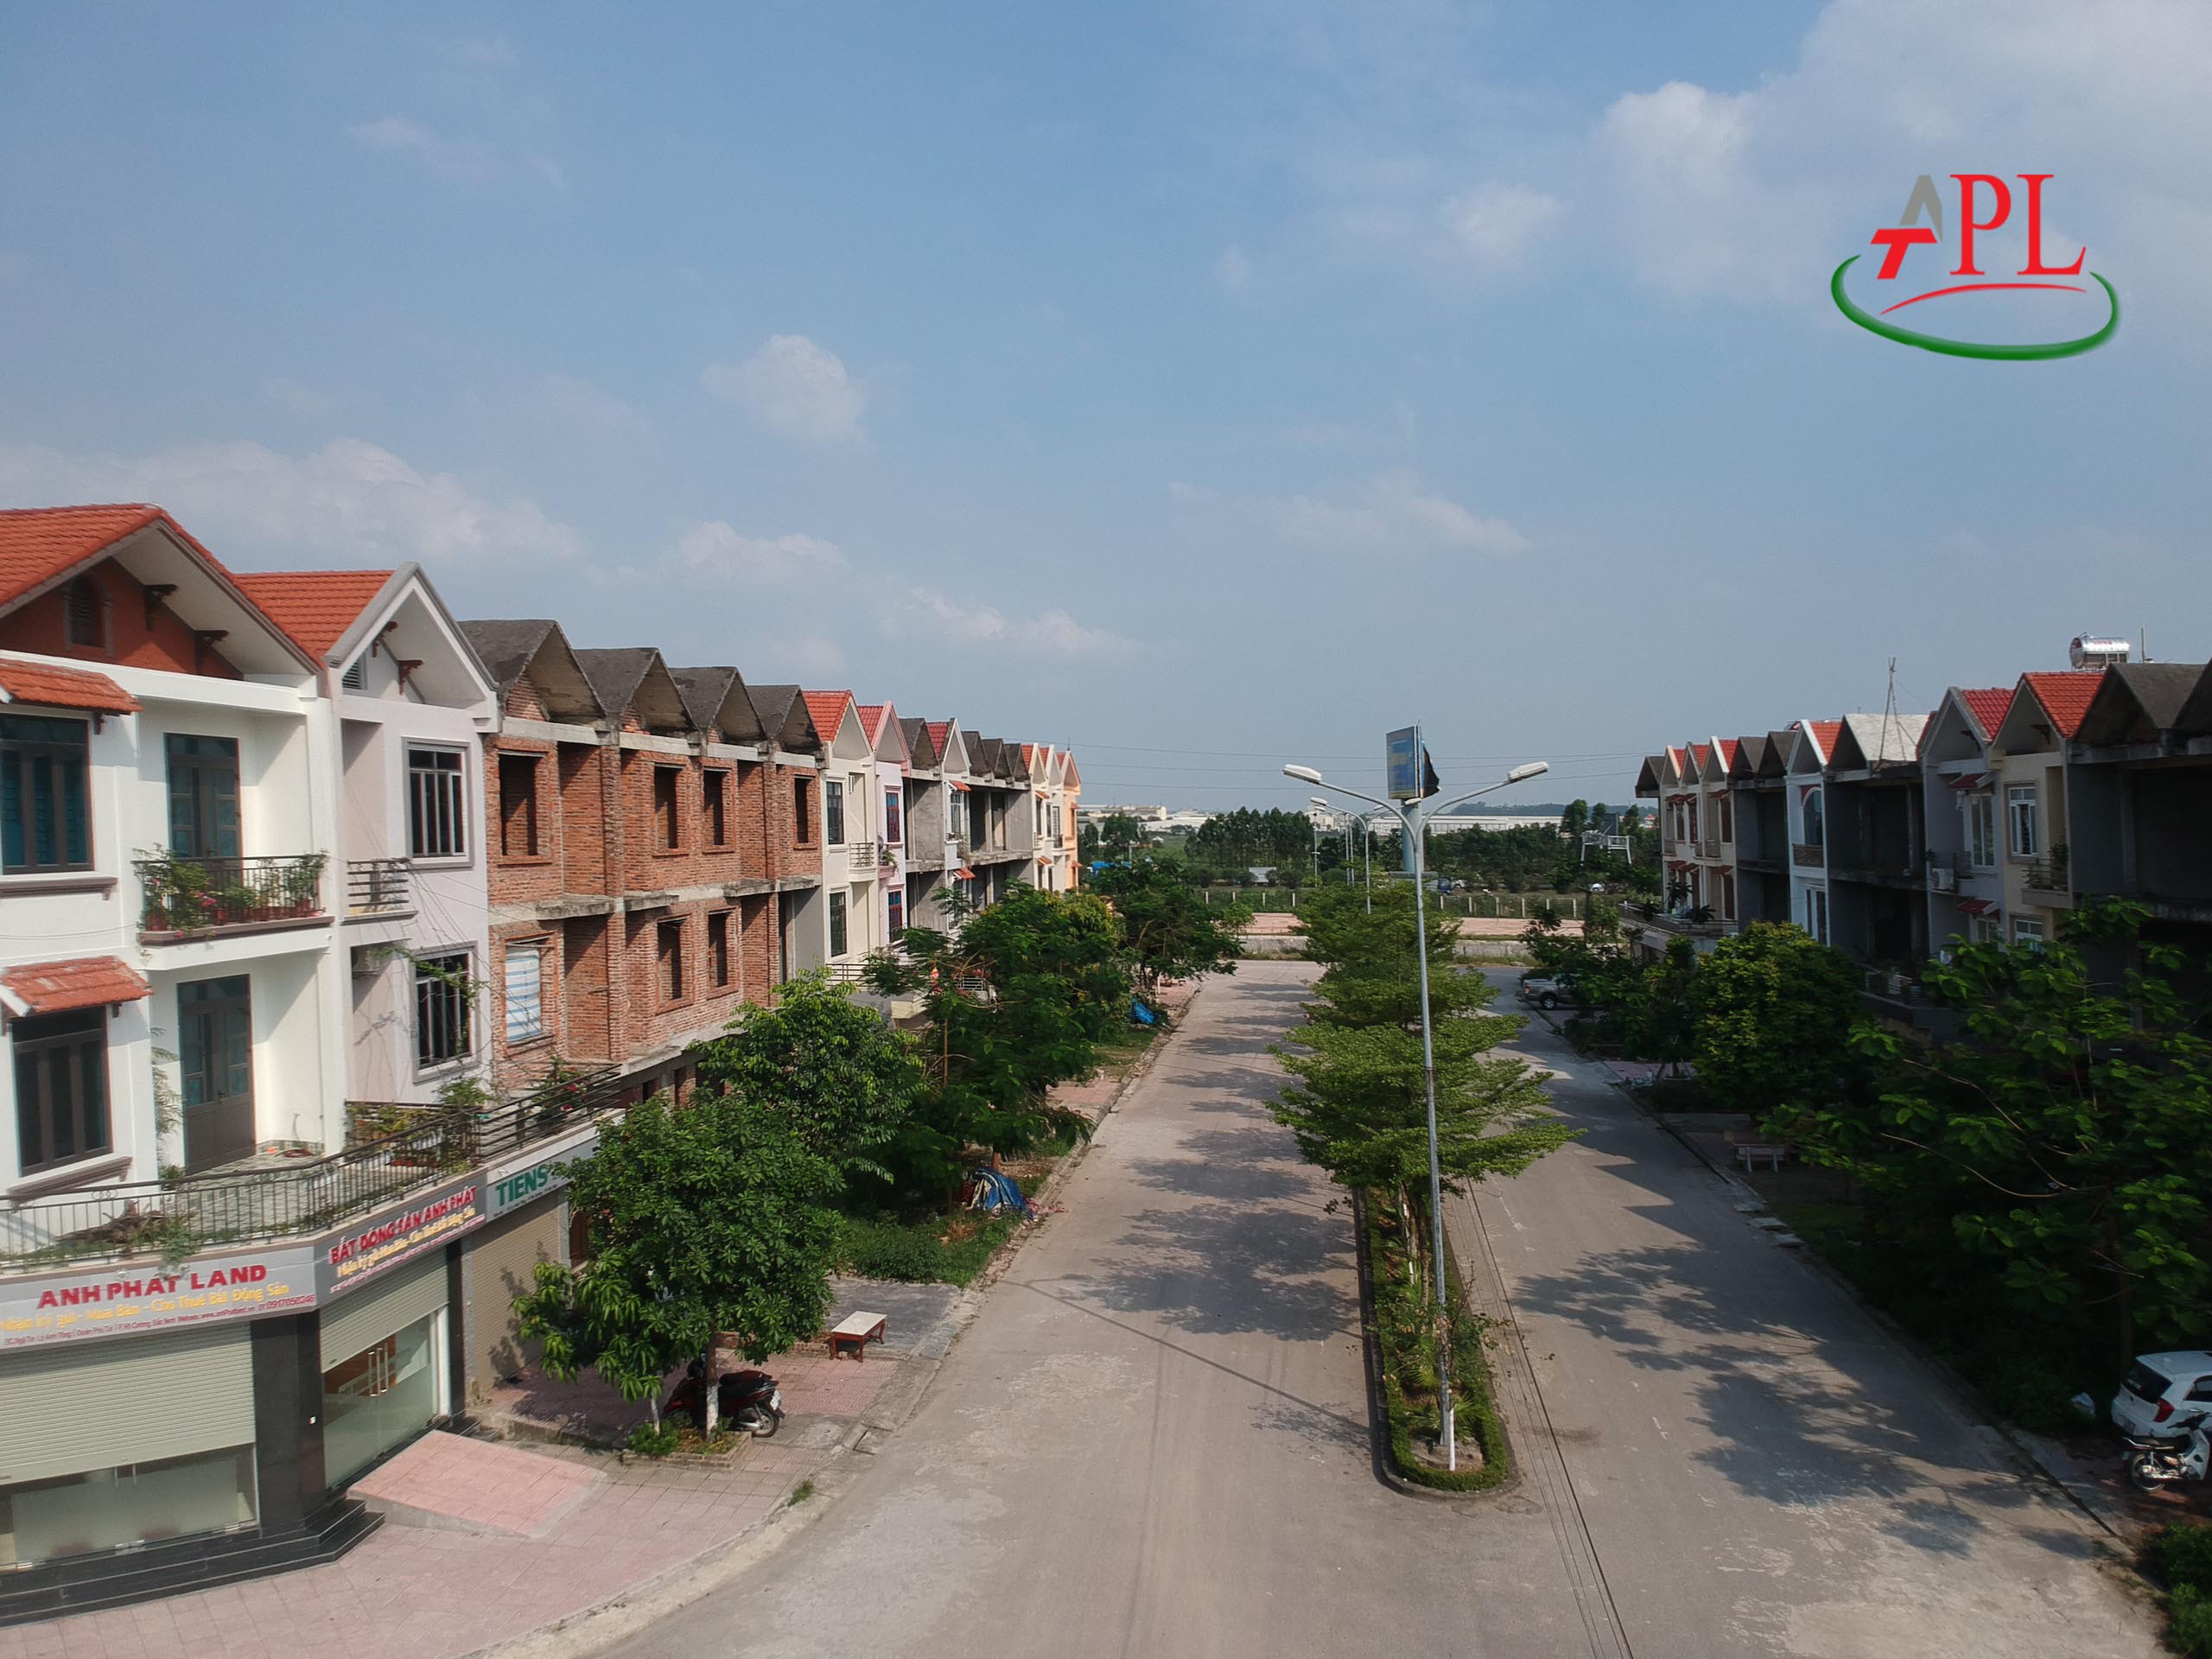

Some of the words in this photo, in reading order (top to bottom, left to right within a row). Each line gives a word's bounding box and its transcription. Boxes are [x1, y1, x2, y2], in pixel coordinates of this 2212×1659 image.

[496, 1163, 548, 1207] TIENS
[420, 1198, 448, 1223] ANH
[37, 1284, 101, 1309] ANH
[106, 1273, 181, 1300] PHÁT
[190, 1264, 267, 1290] LAND
